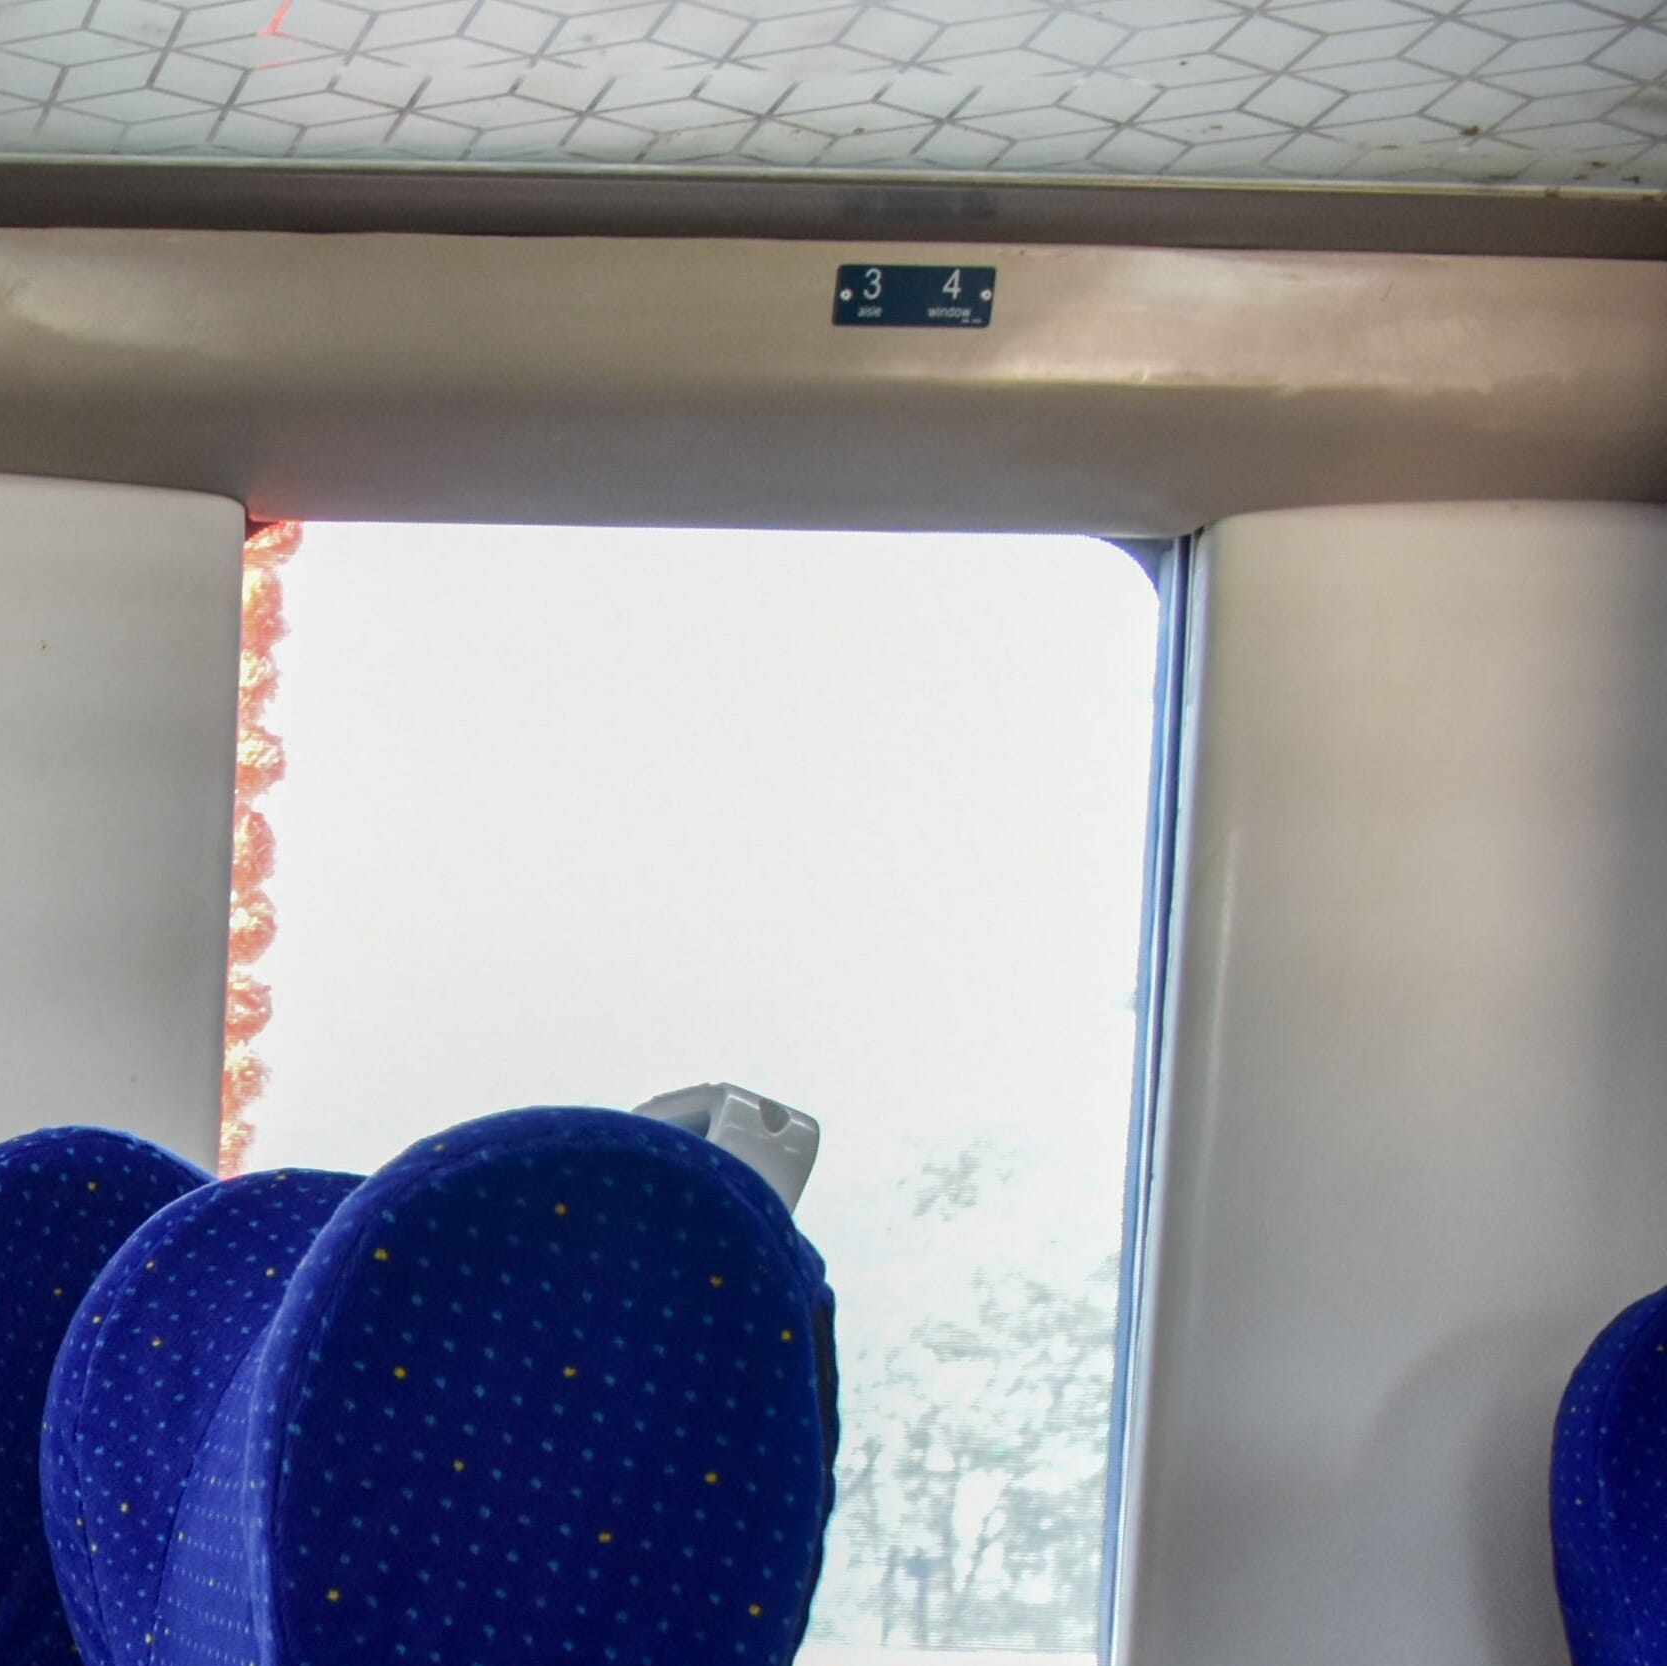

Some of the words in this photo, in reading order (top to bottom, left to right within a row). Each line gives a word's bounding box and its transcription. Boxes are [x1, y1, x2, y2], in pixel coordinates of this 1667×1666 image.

[863, 268, 882, 300] 3
[942, 269, 962, 300] 4
[857, 306, 883, 317] aisle
[927, 307, 971, 317] window
